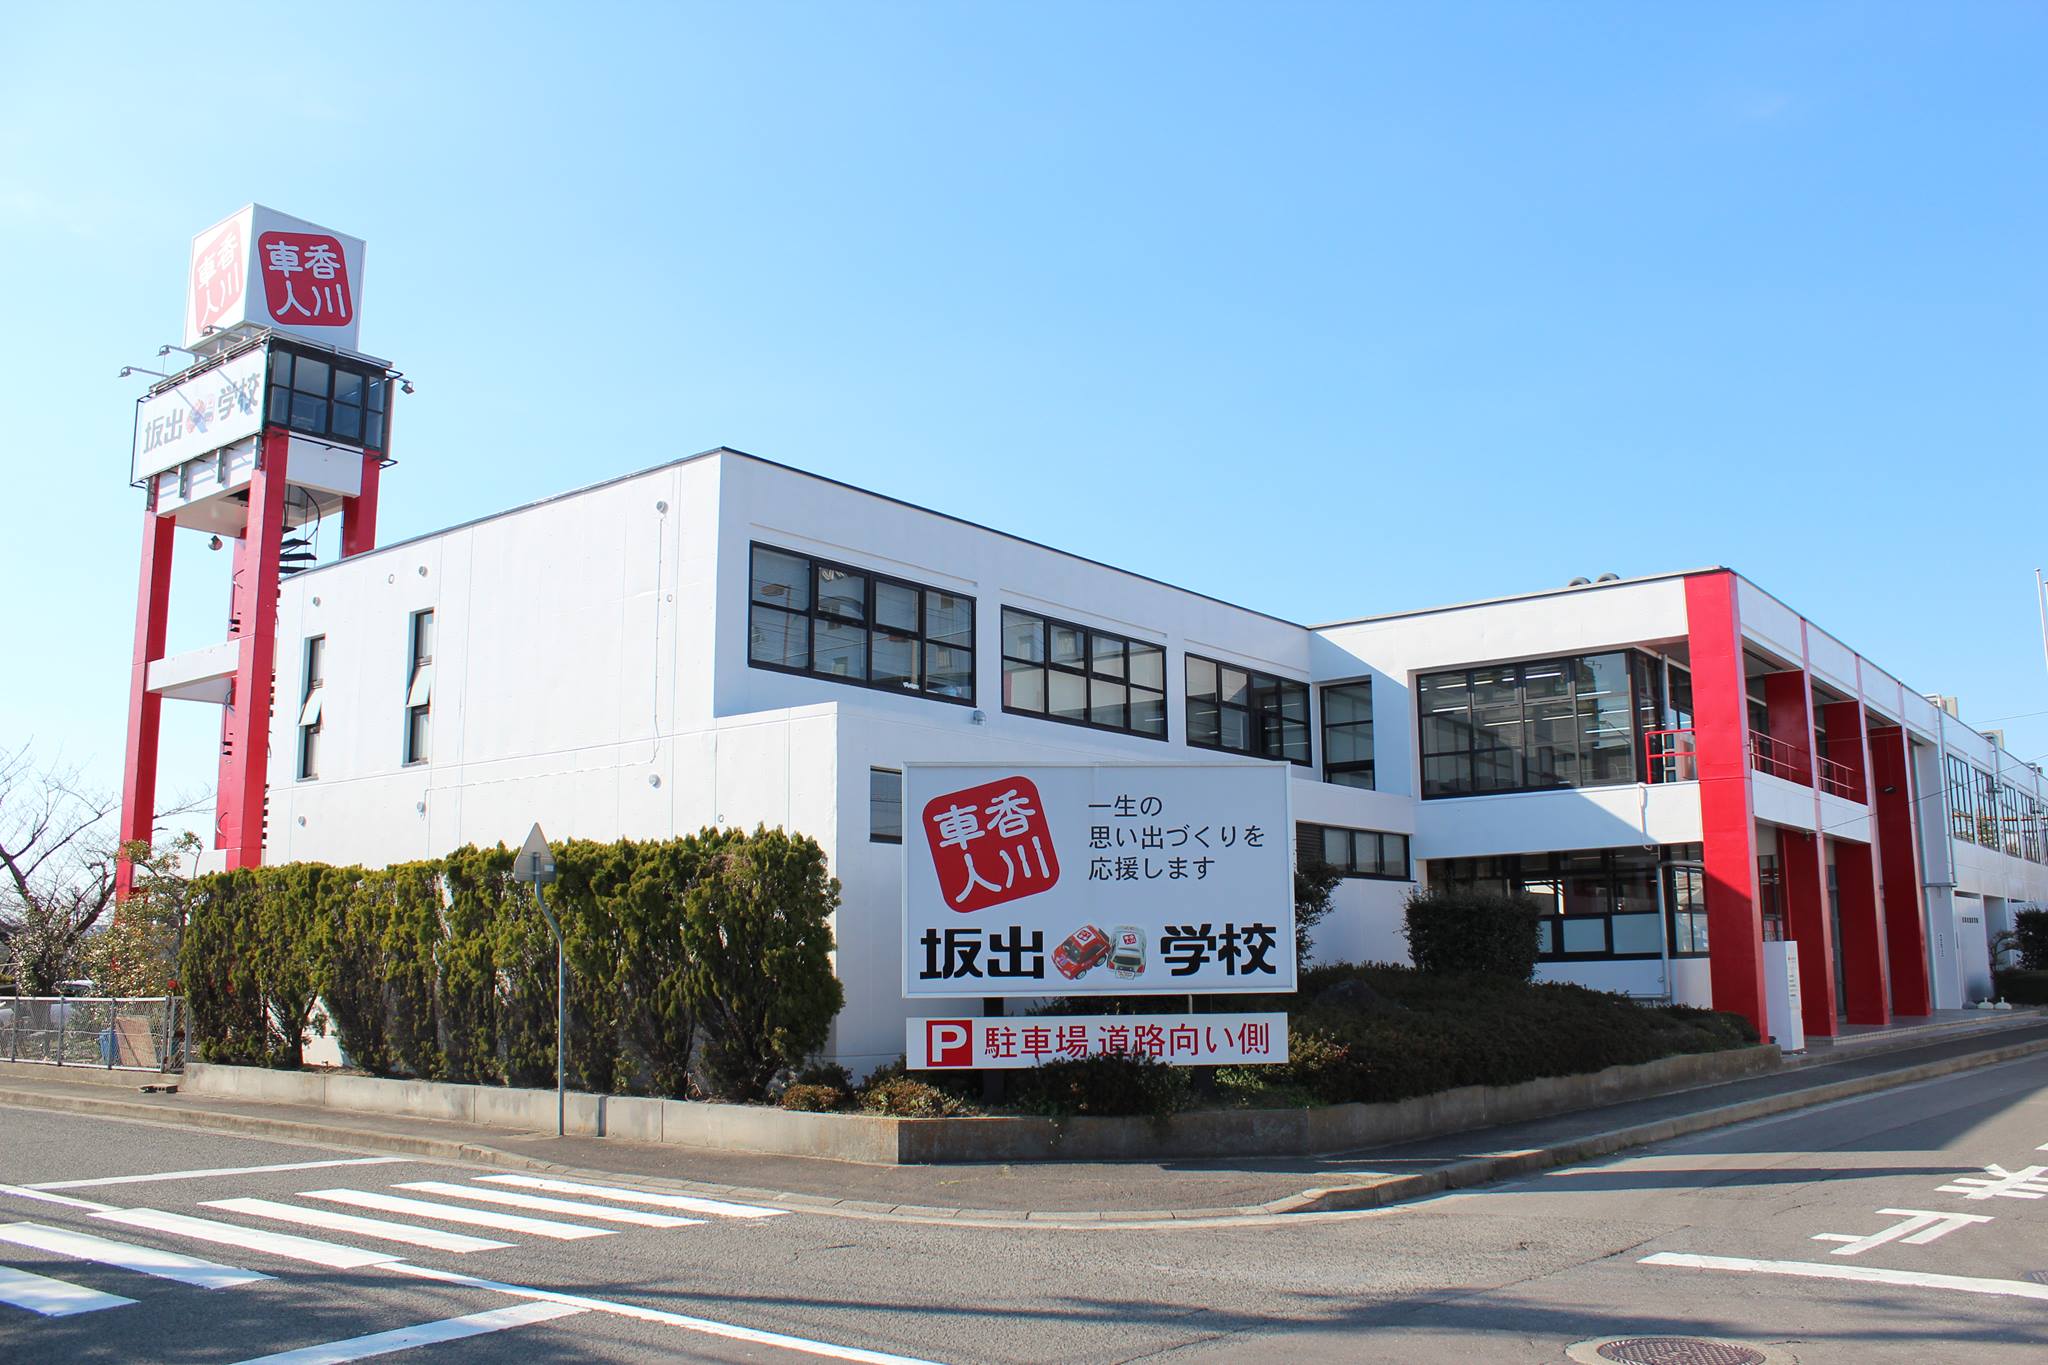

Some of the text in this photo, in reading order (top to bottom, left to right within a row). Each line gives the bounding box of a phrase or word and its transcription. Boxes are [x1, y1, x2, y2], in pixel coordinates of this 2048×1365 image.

[1088, 794, 1163, 818] 一生の
[1089, 824, 1266, 850] 思い出づくりを
[1088, 856, 1216, 882] 応援します
[919, 923, 1278, 980] 坂出 学校
[931, 1024, 968, 1064] P
